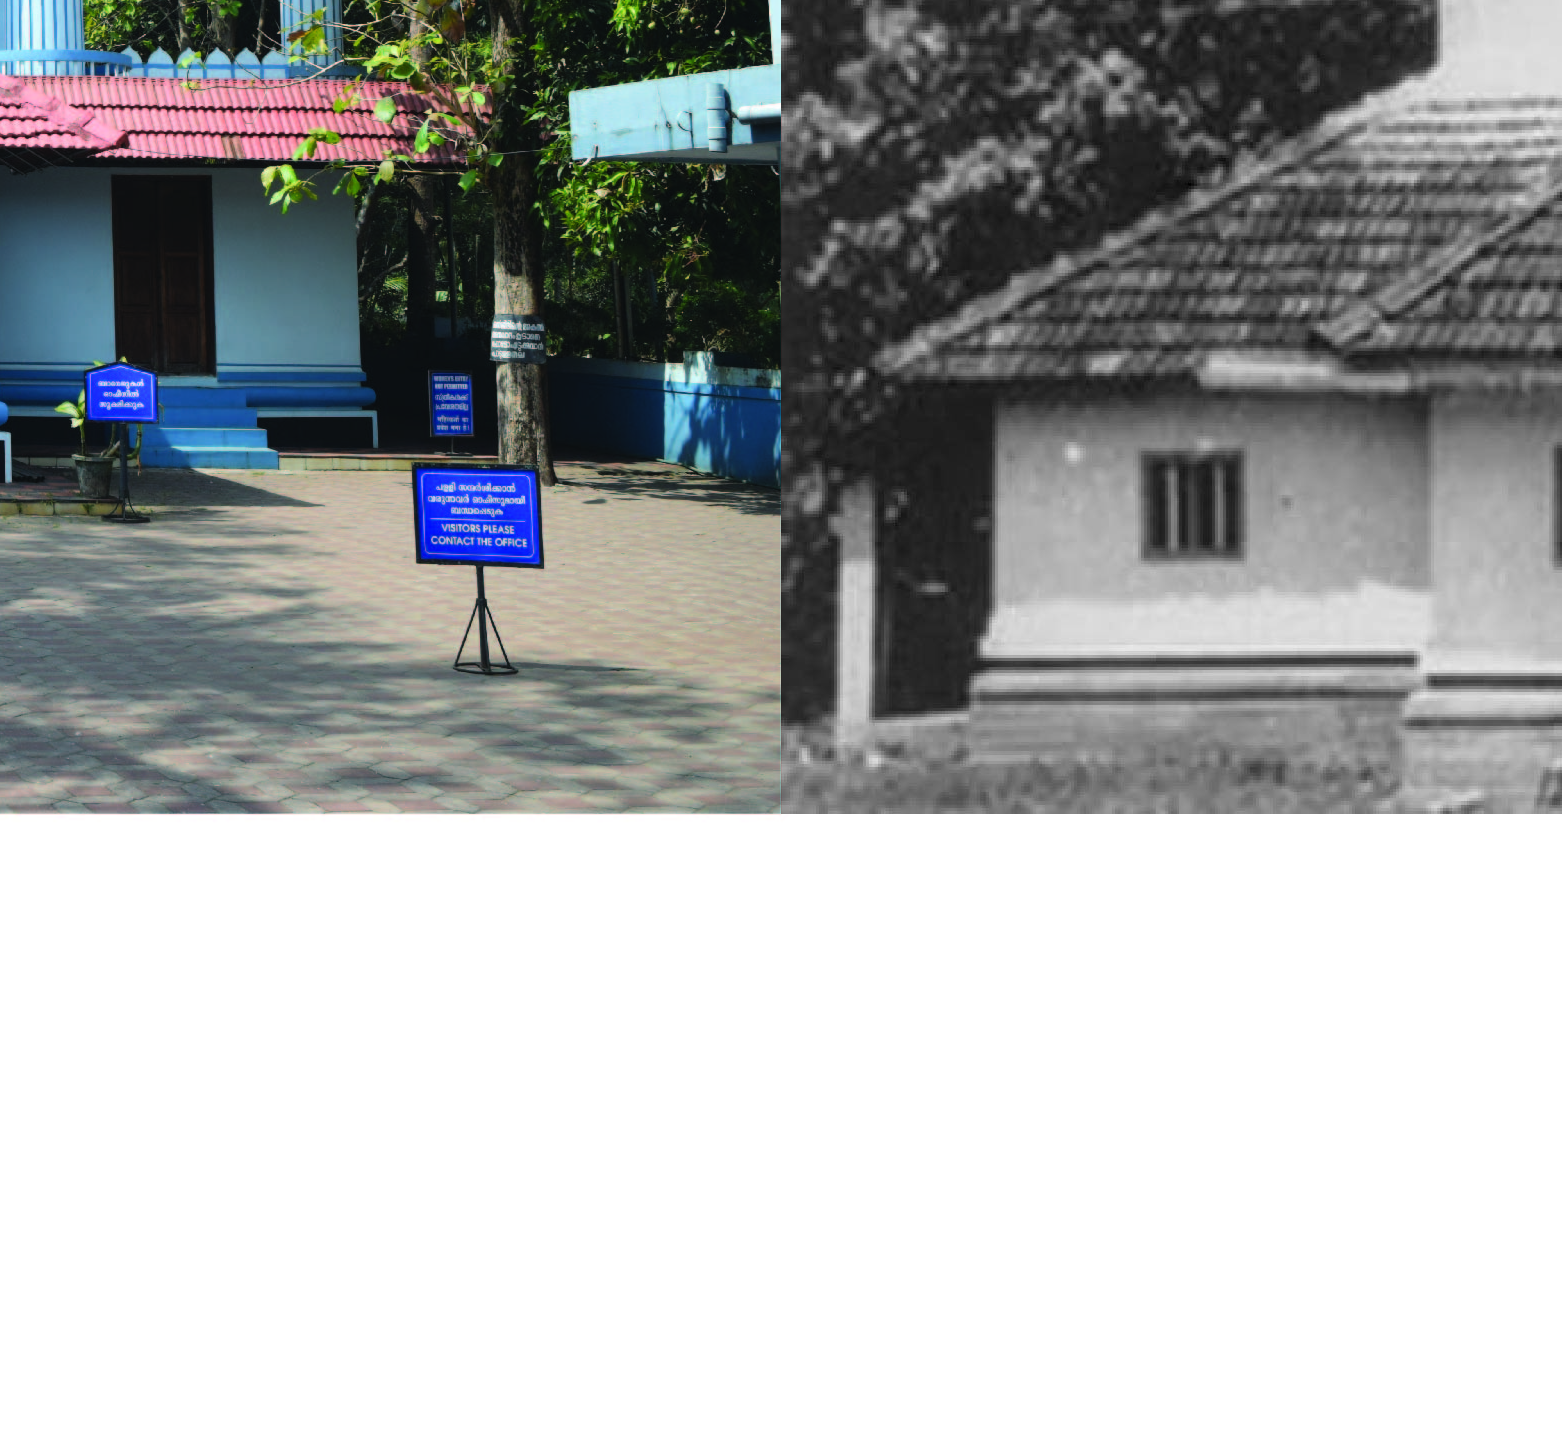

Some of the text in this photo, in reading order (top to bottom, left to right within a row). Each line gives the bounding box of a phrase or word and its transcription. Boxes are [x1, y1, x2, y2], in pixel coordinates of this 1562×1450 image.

[441, 524, 515, 534] VISITORS PLEASE
[431, 536, 528, 548] CONTACT THE OFFICE
